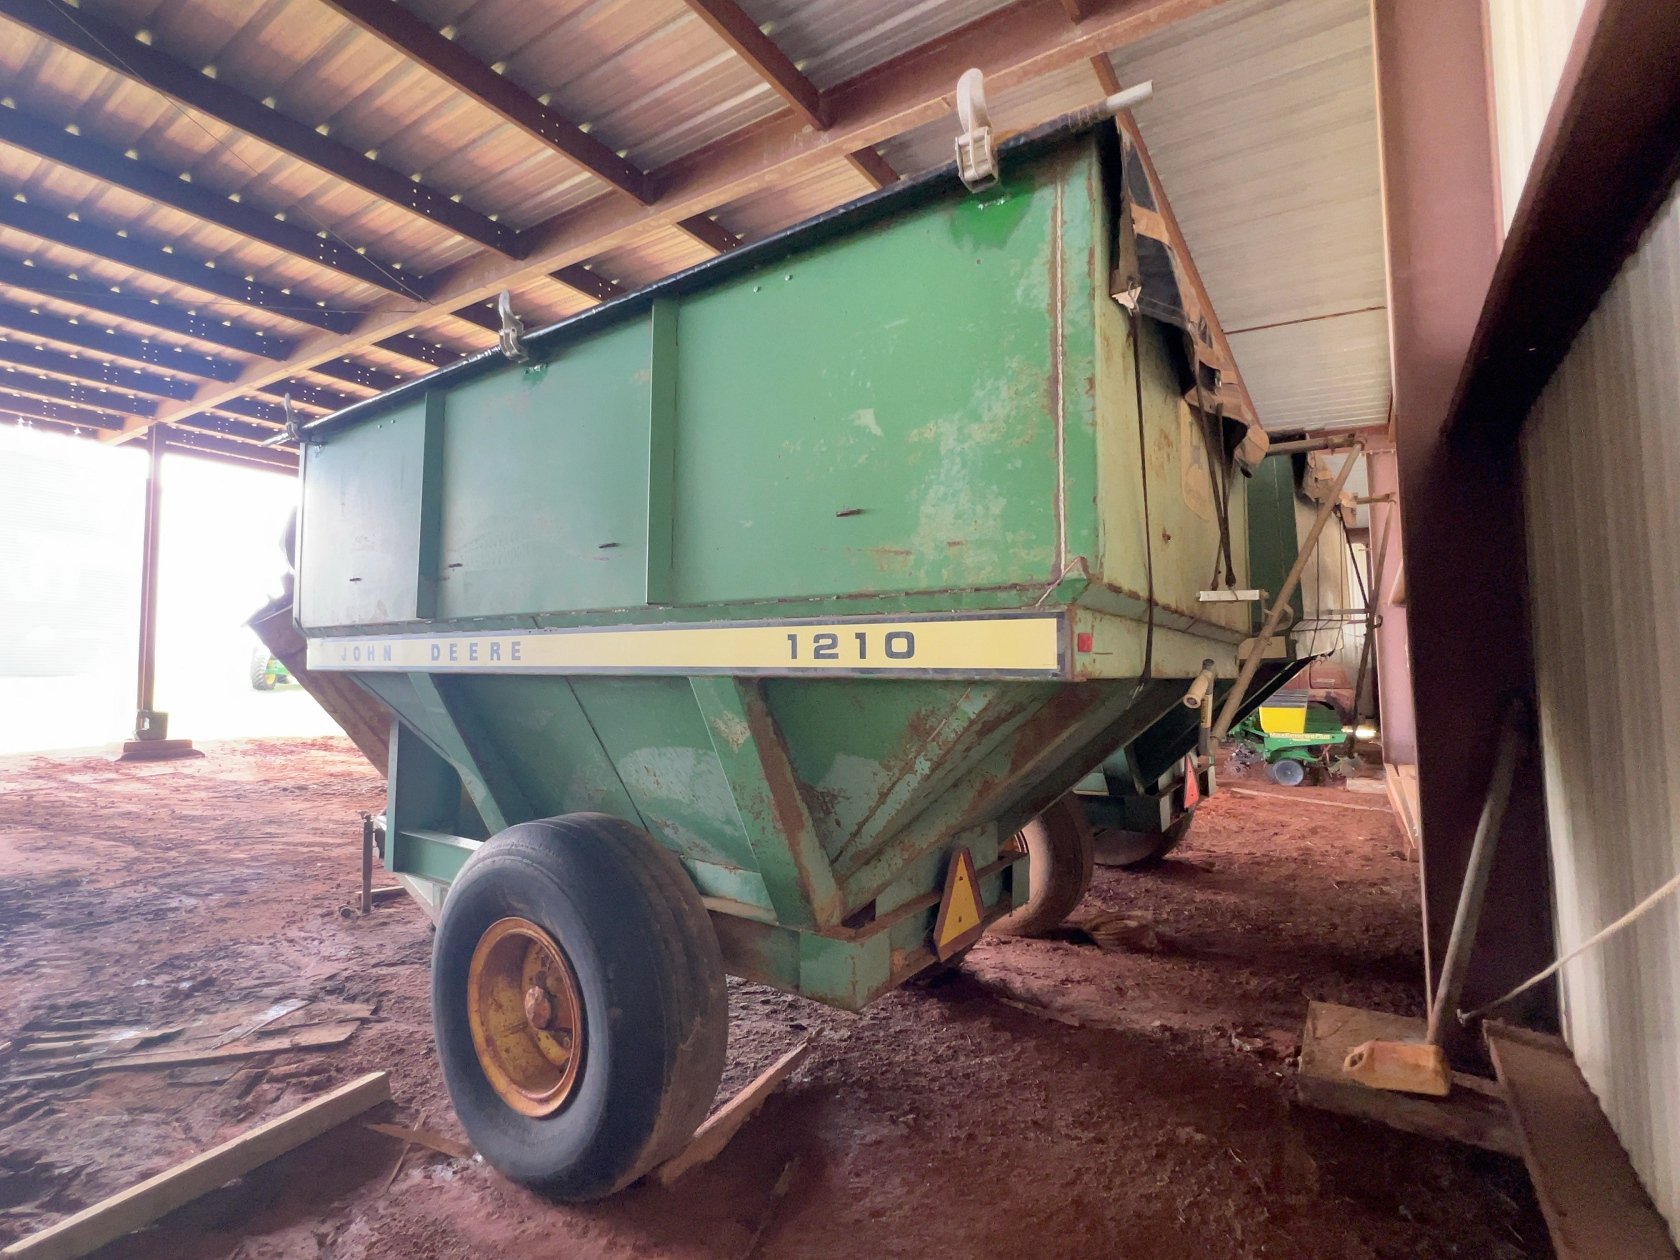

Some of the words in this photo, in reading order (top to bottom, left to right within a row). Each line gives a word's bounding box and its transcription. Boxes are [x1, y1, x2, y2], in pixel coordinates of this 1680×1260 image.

[340, 645, 392, 662] JOHN
[431, 641, 522, 662] DEERE
[787, 631, 915, 660] 1210
